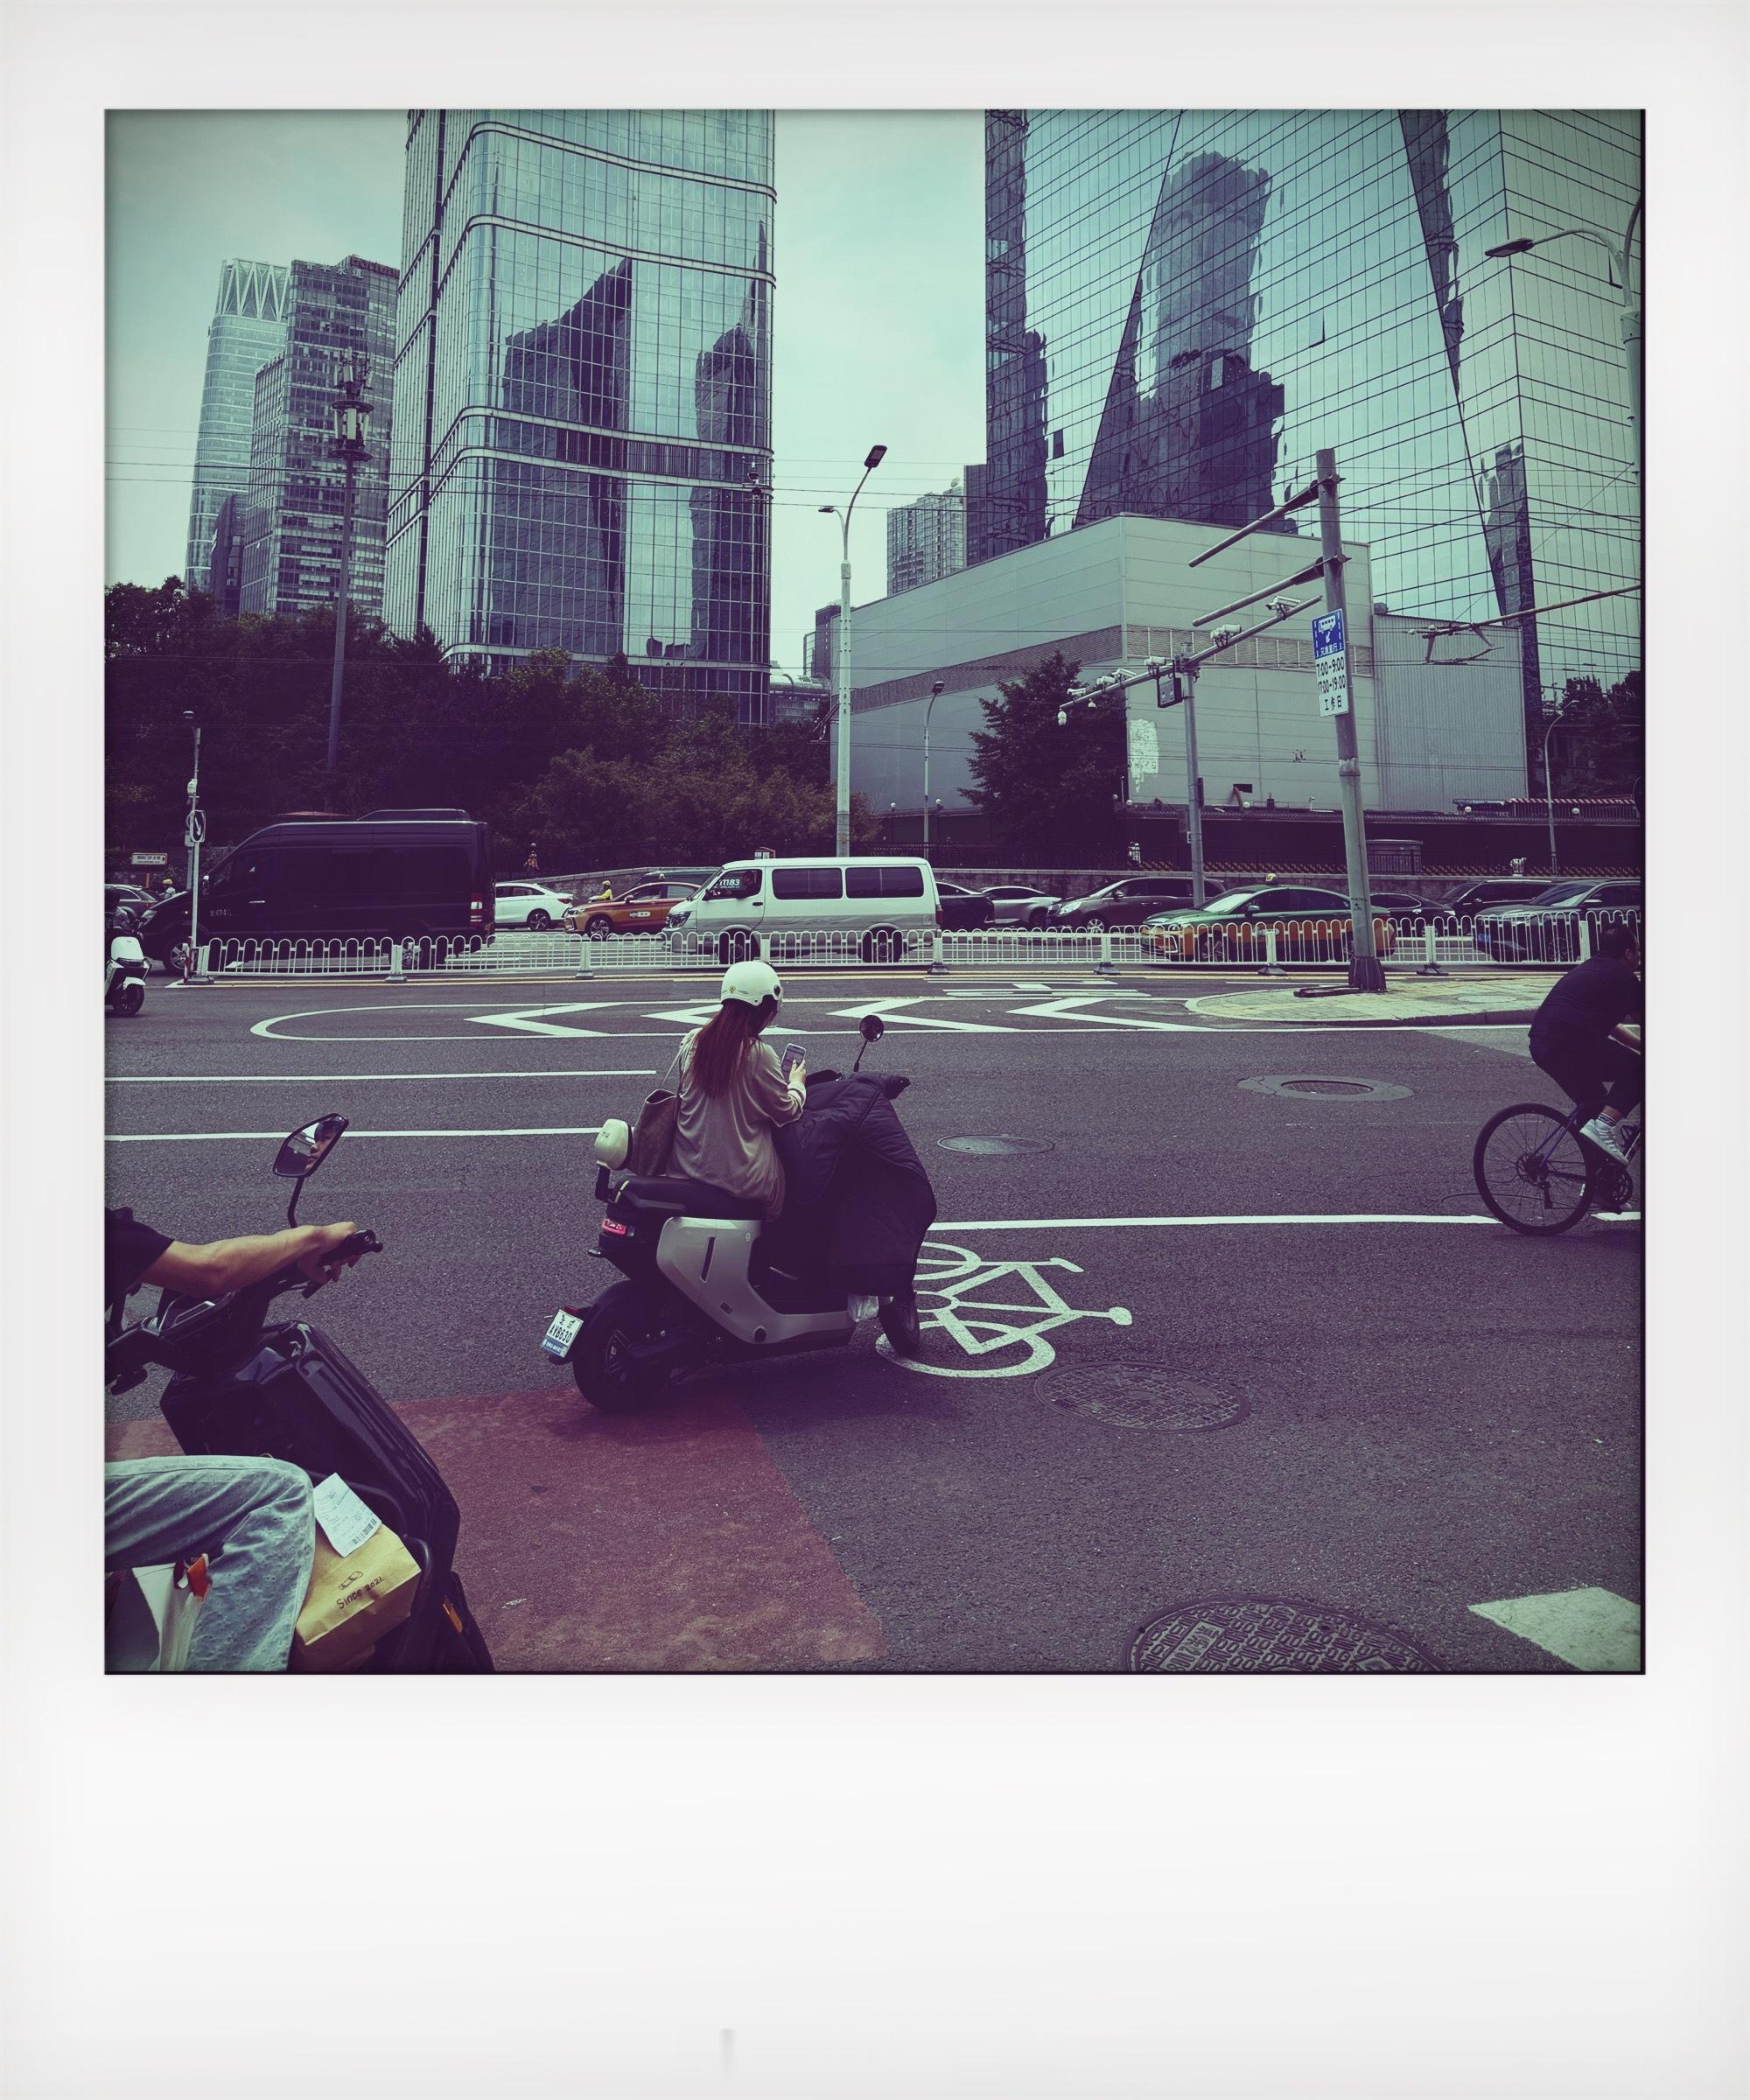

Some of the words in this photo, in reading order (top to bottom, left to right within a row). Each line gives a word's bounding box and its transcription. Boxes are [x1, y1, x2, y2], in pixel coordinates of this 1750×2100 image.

[1316, 656, 1345, 678] 7:00-9:00
[1317, 675, 1347, 695] 17:00-19:00
[1324, 695, 1342, 710] 工作日
[336, 1588, 363, 1609] Since
